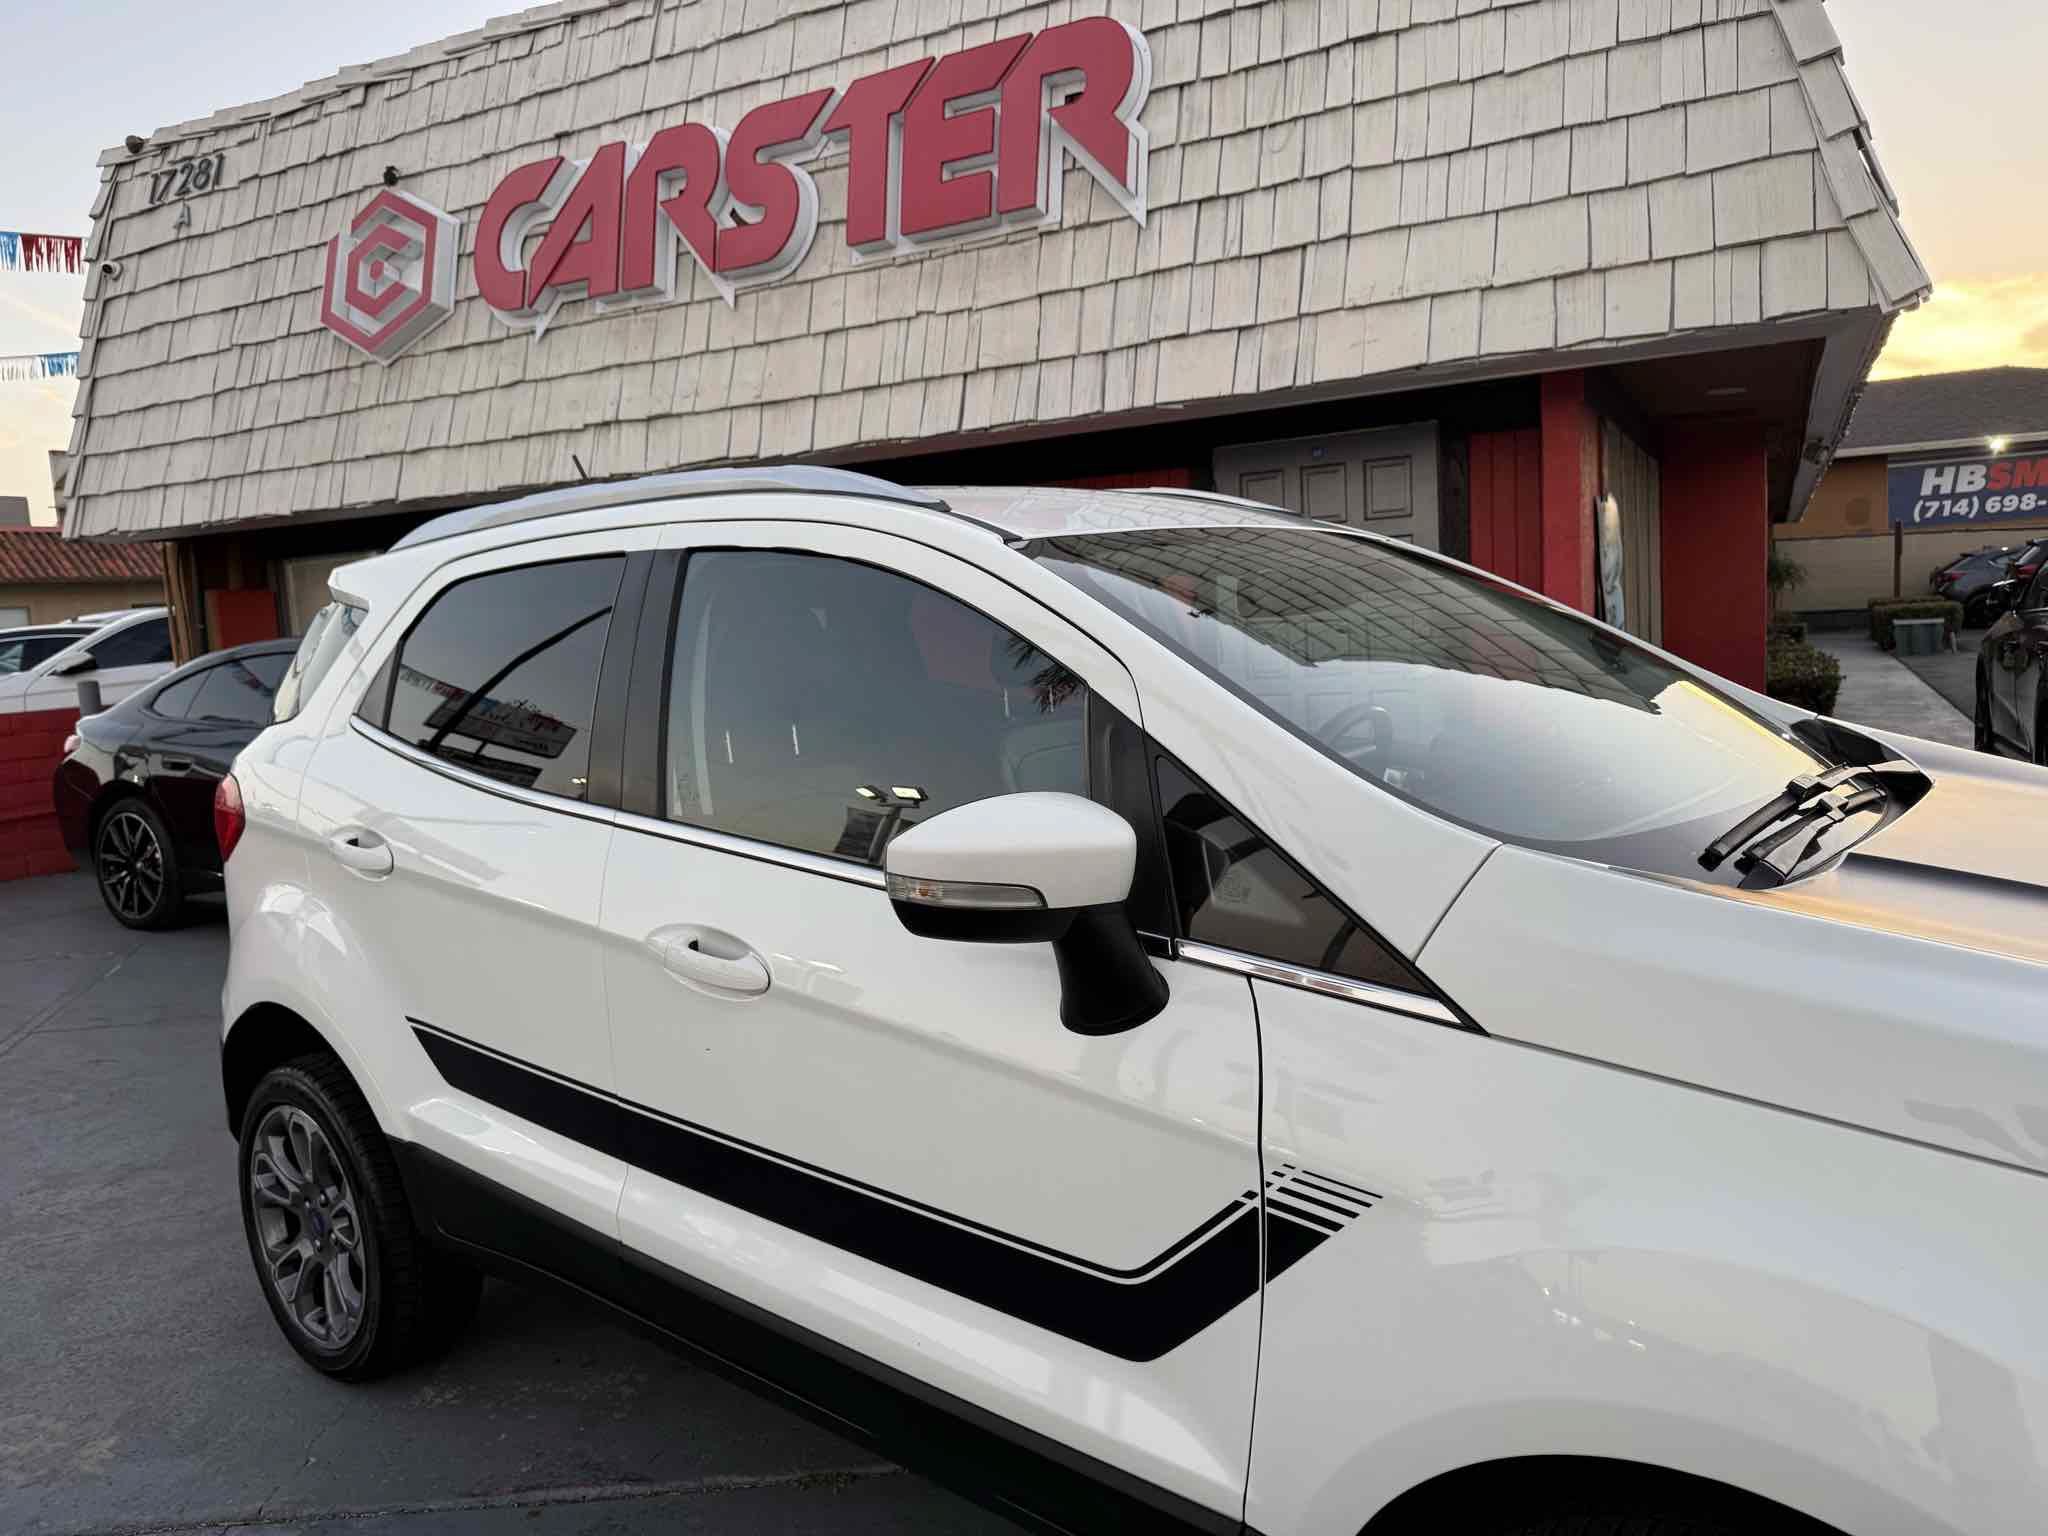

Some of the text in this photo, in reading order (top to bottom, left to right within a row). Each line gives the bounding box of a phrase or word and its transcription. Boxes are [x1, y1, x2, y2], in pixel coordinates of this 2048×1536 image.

[148, 152, 225, 205] 17281
[474, 15, 1146, 325] CARSTER
[173, 203, 192, 228] A
[1913, 495, 1980, 523] (714)
